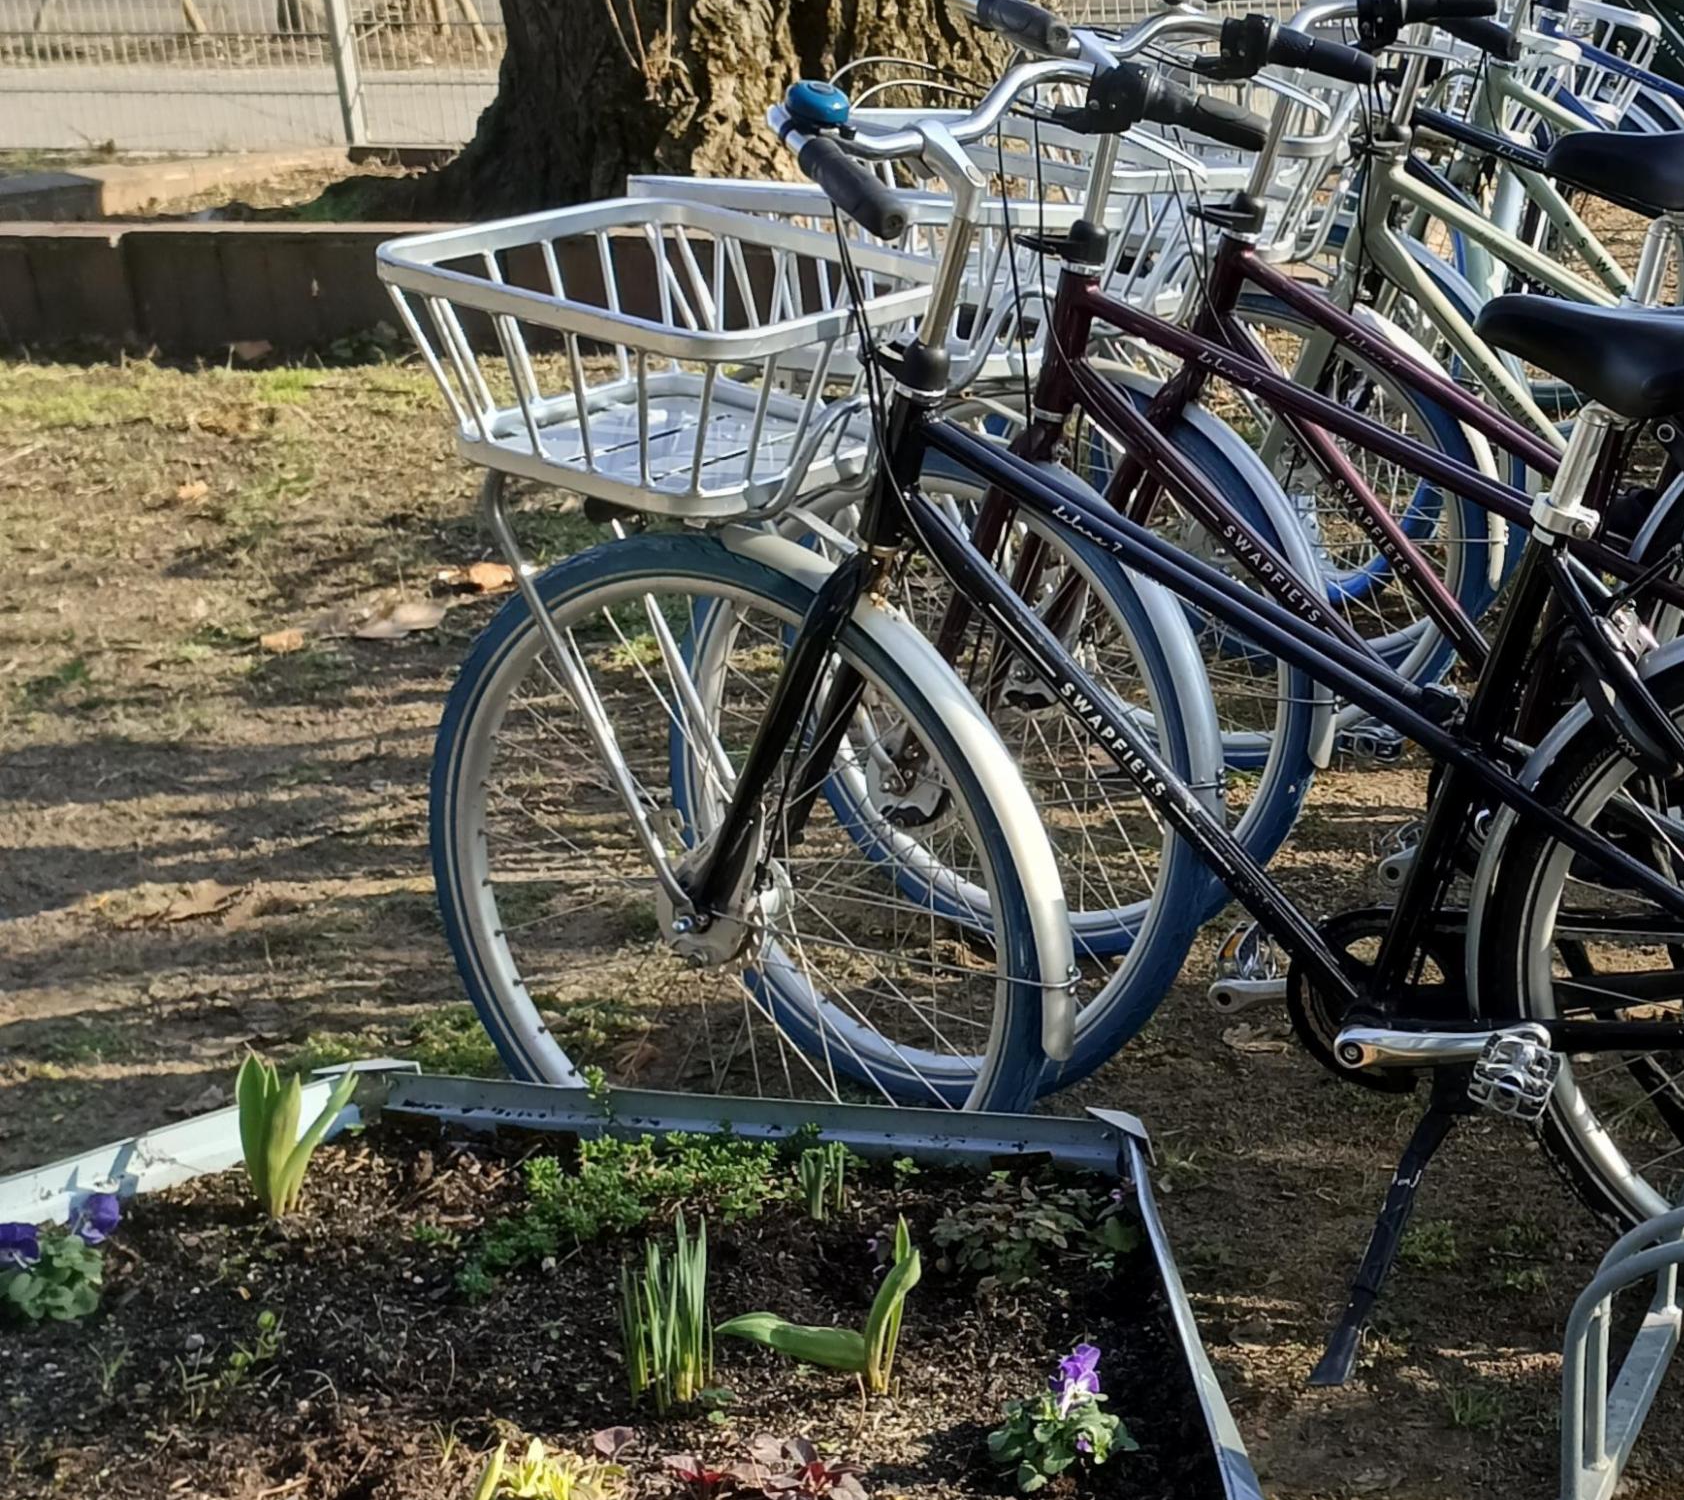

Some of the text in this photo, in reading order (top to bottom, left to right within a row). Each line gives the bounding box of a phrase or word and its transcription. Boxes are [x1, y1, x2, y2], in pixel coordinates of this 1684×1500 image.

[1111, 541, 1123, 552] 7
[1223, 525, 1321, 623] SWAPFIETS
[1334, 478, 1411, 575] SWAPFIETS
[1060, 682, 1166, 796] SWAPFIETS
